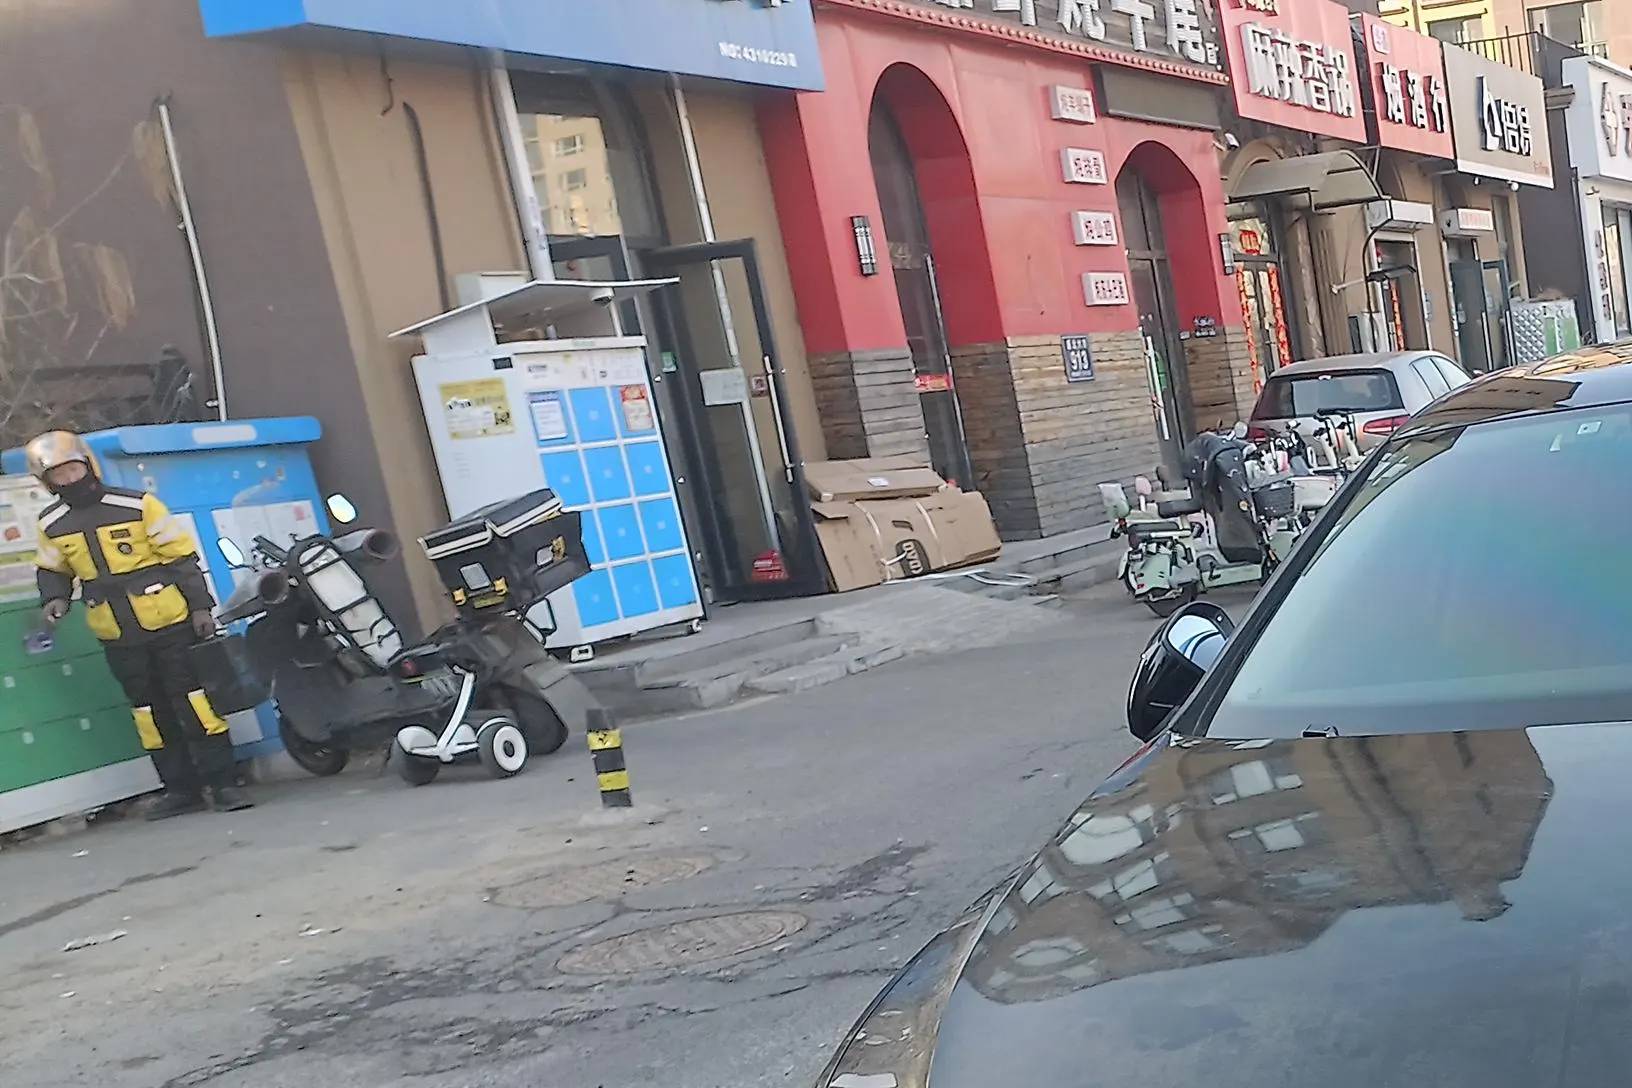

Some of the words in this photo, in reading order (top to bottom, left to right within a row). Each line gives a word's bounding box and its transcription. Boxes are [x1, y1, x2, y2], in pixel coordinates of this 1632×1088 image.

[1239, 22, 1356, 119] 麻辣香锅
[1379, 62, 1447, 134] 烟酒行
